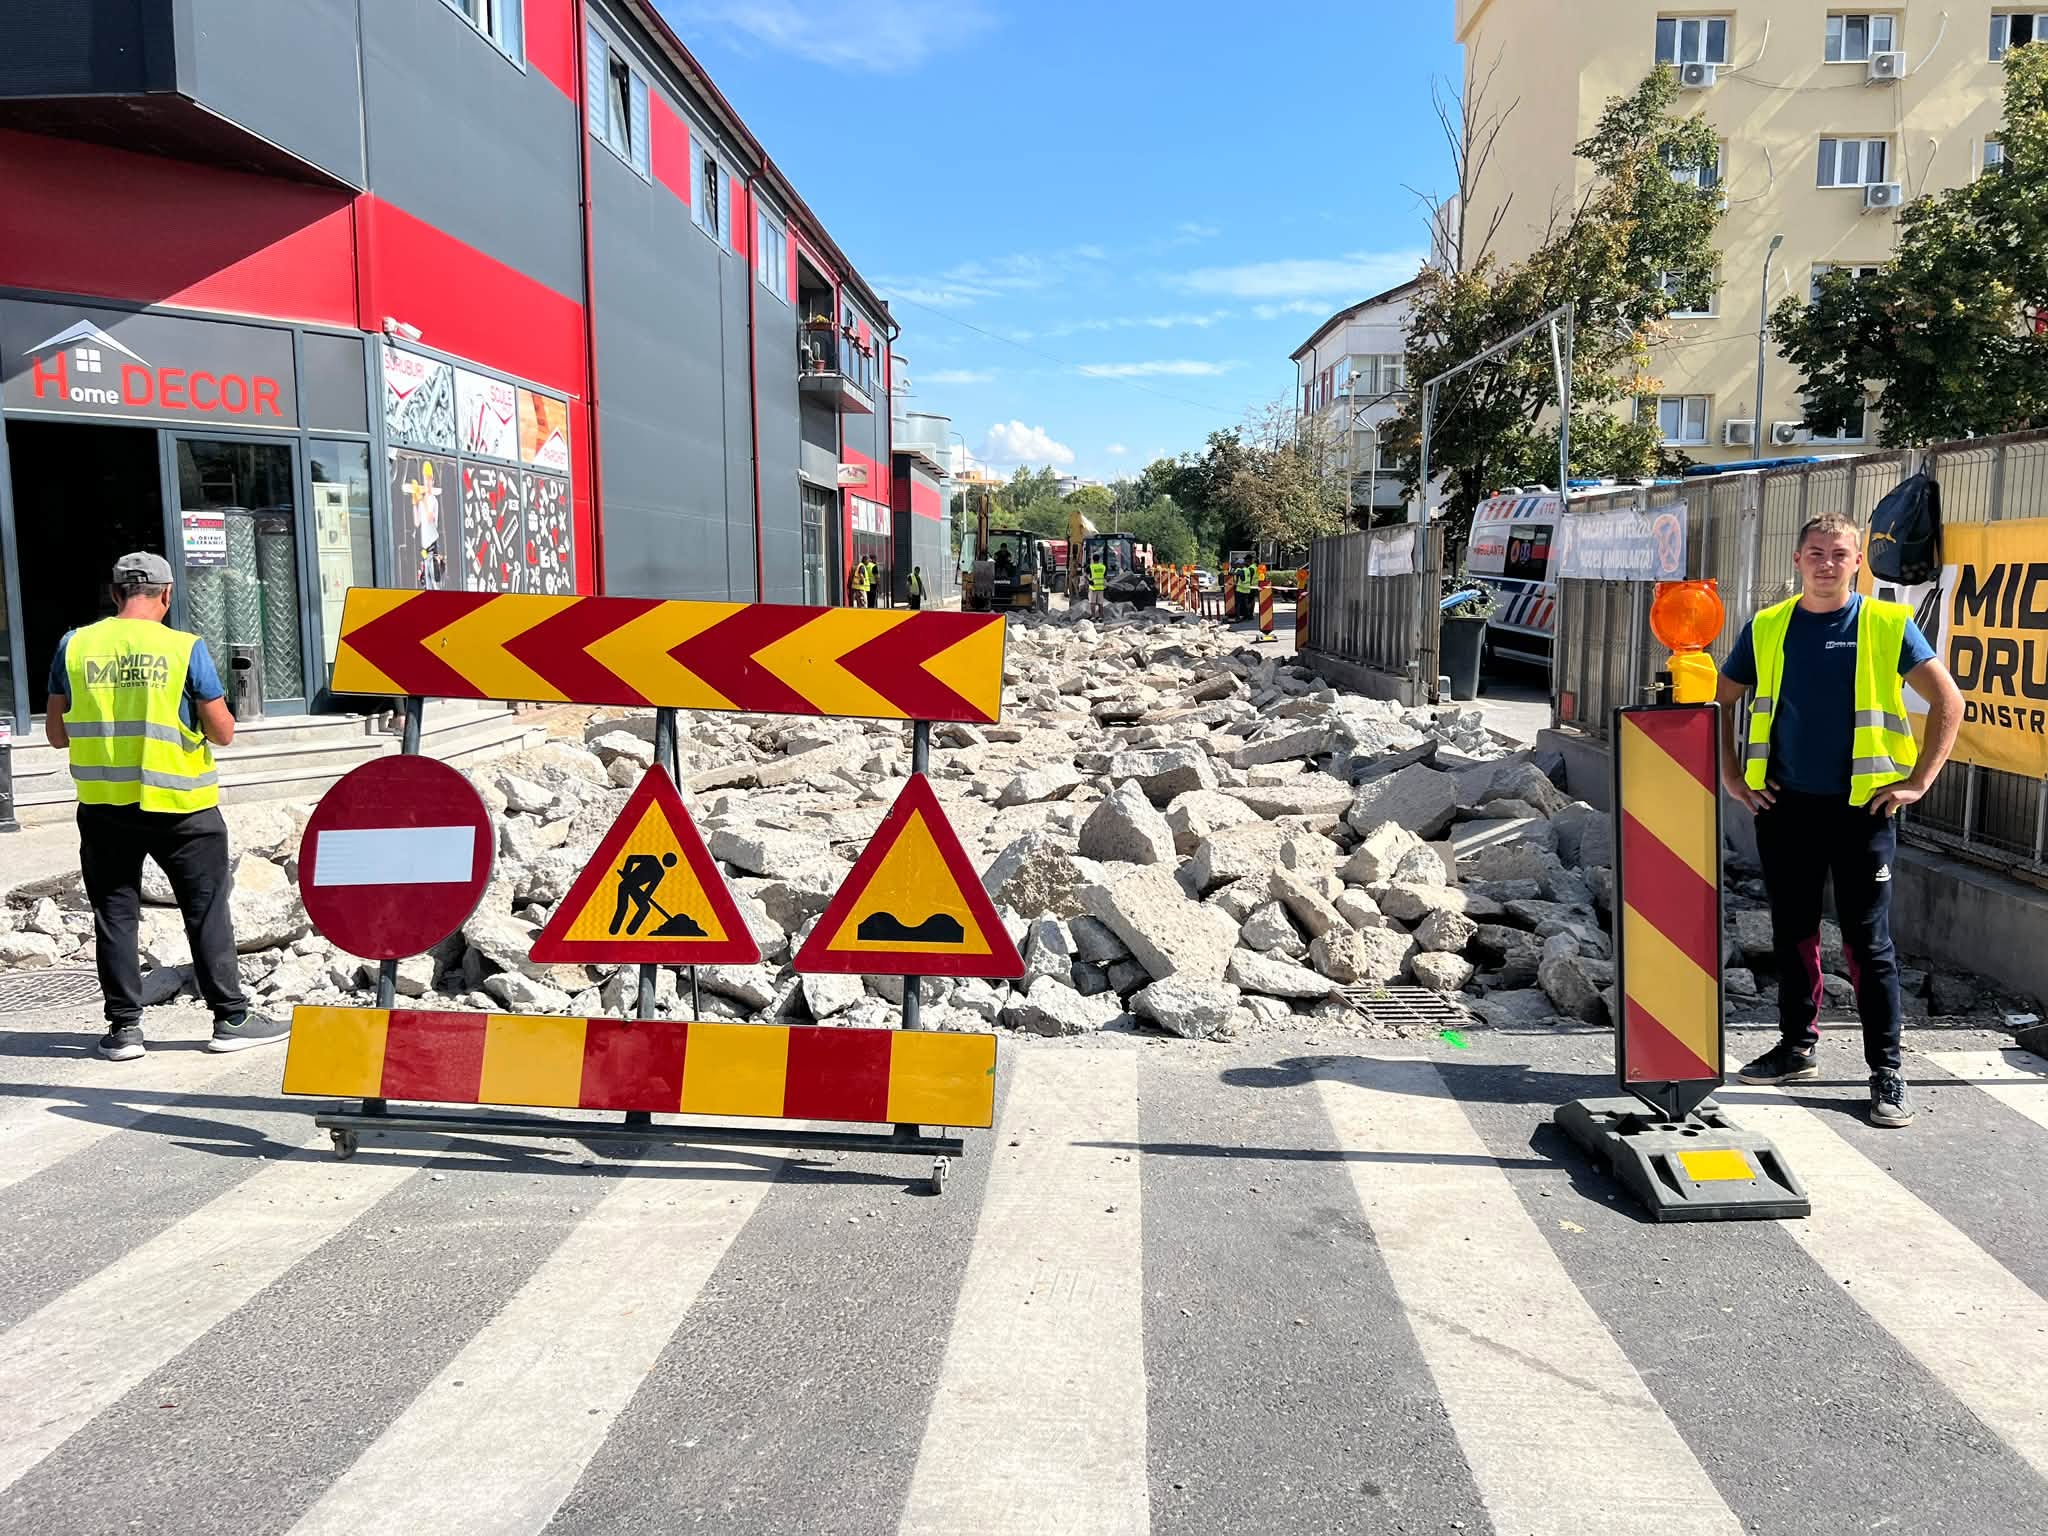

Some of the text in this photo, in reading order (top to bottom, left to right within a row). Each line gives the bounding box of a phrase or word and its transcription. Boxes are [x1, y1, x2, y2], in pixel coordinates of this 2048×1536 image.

[32, 351, 284, 417] Home DECOR
[120, 654, 168, 670] MIDA
[120, 668, 168, 684] DRUM
[1963, 700, 2045, 735] ONSTR
